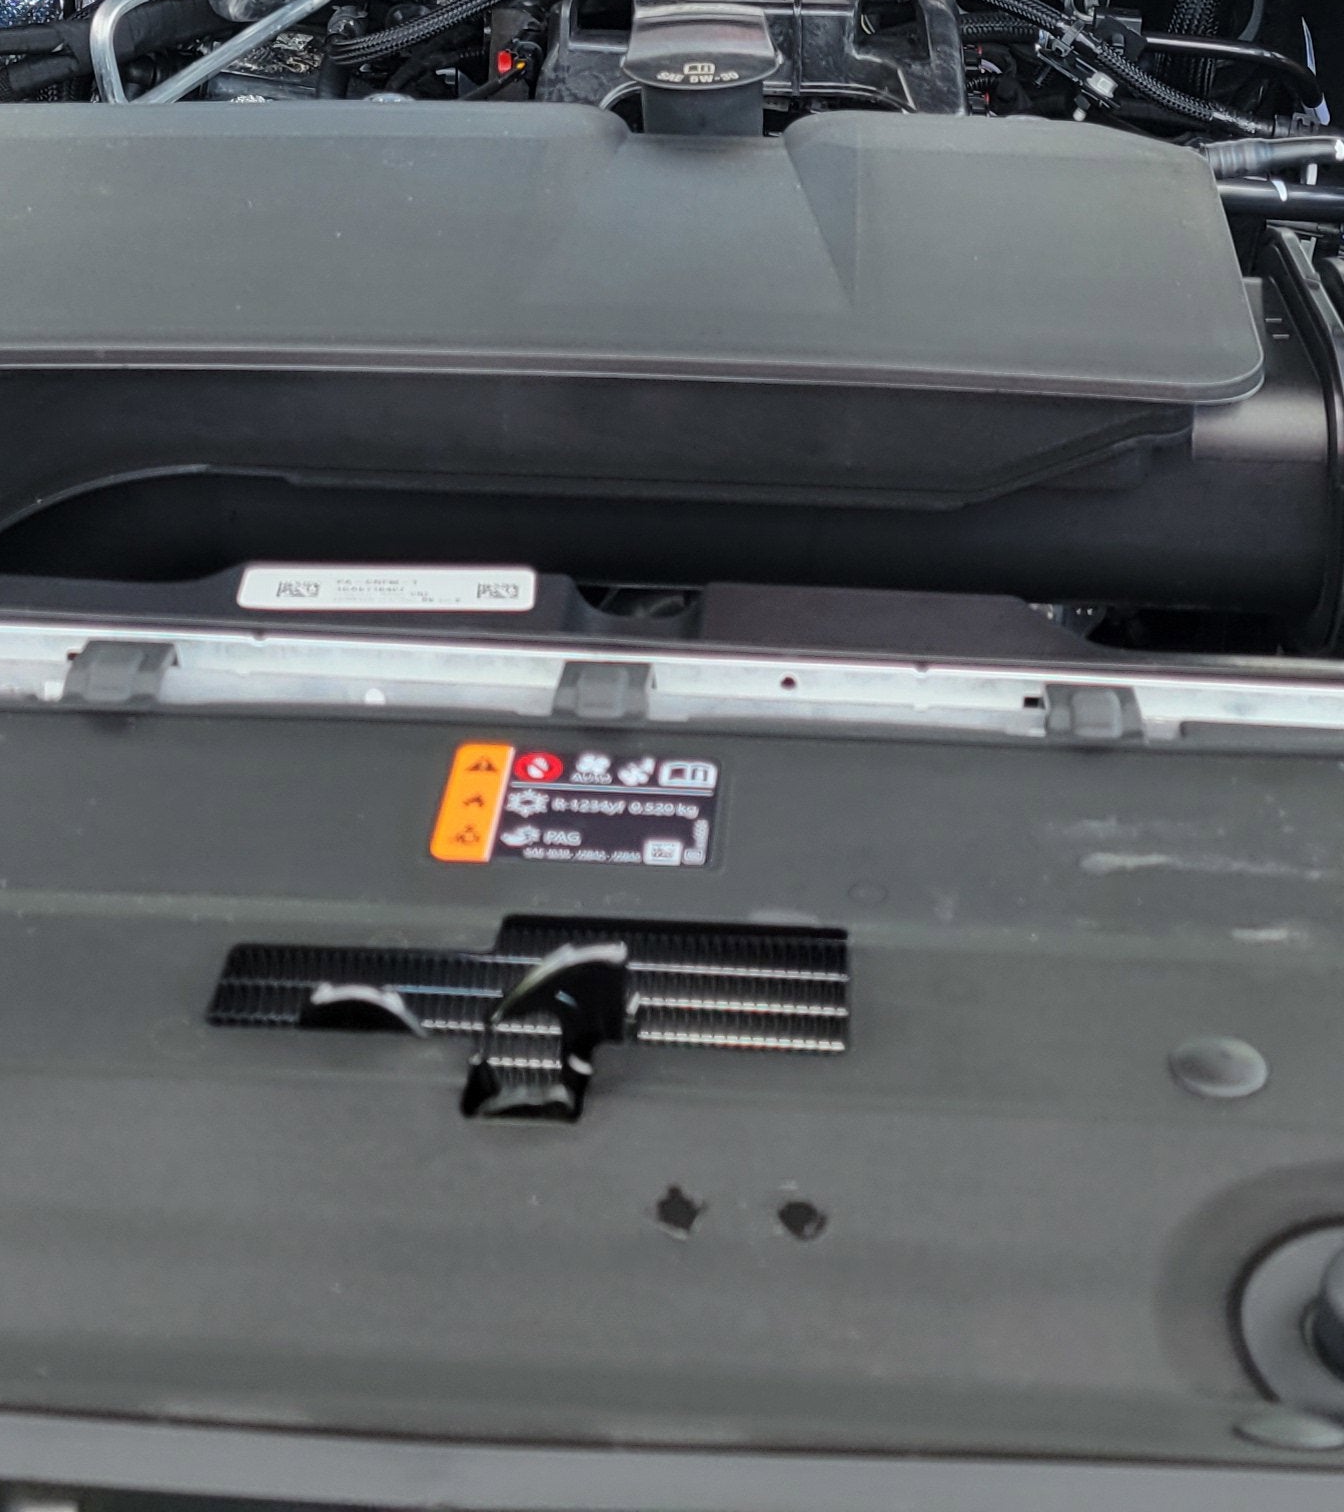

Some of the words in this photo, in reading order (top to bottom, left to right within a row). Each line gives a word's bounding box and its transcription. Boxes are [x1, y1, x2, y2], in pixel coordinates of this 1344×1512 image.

[657, 71, 684, 82] SAE
[570, 772, 613, 784] AUTO
[676, 802, 699, 819] kg
[543, 830, 582, 846] PAG
